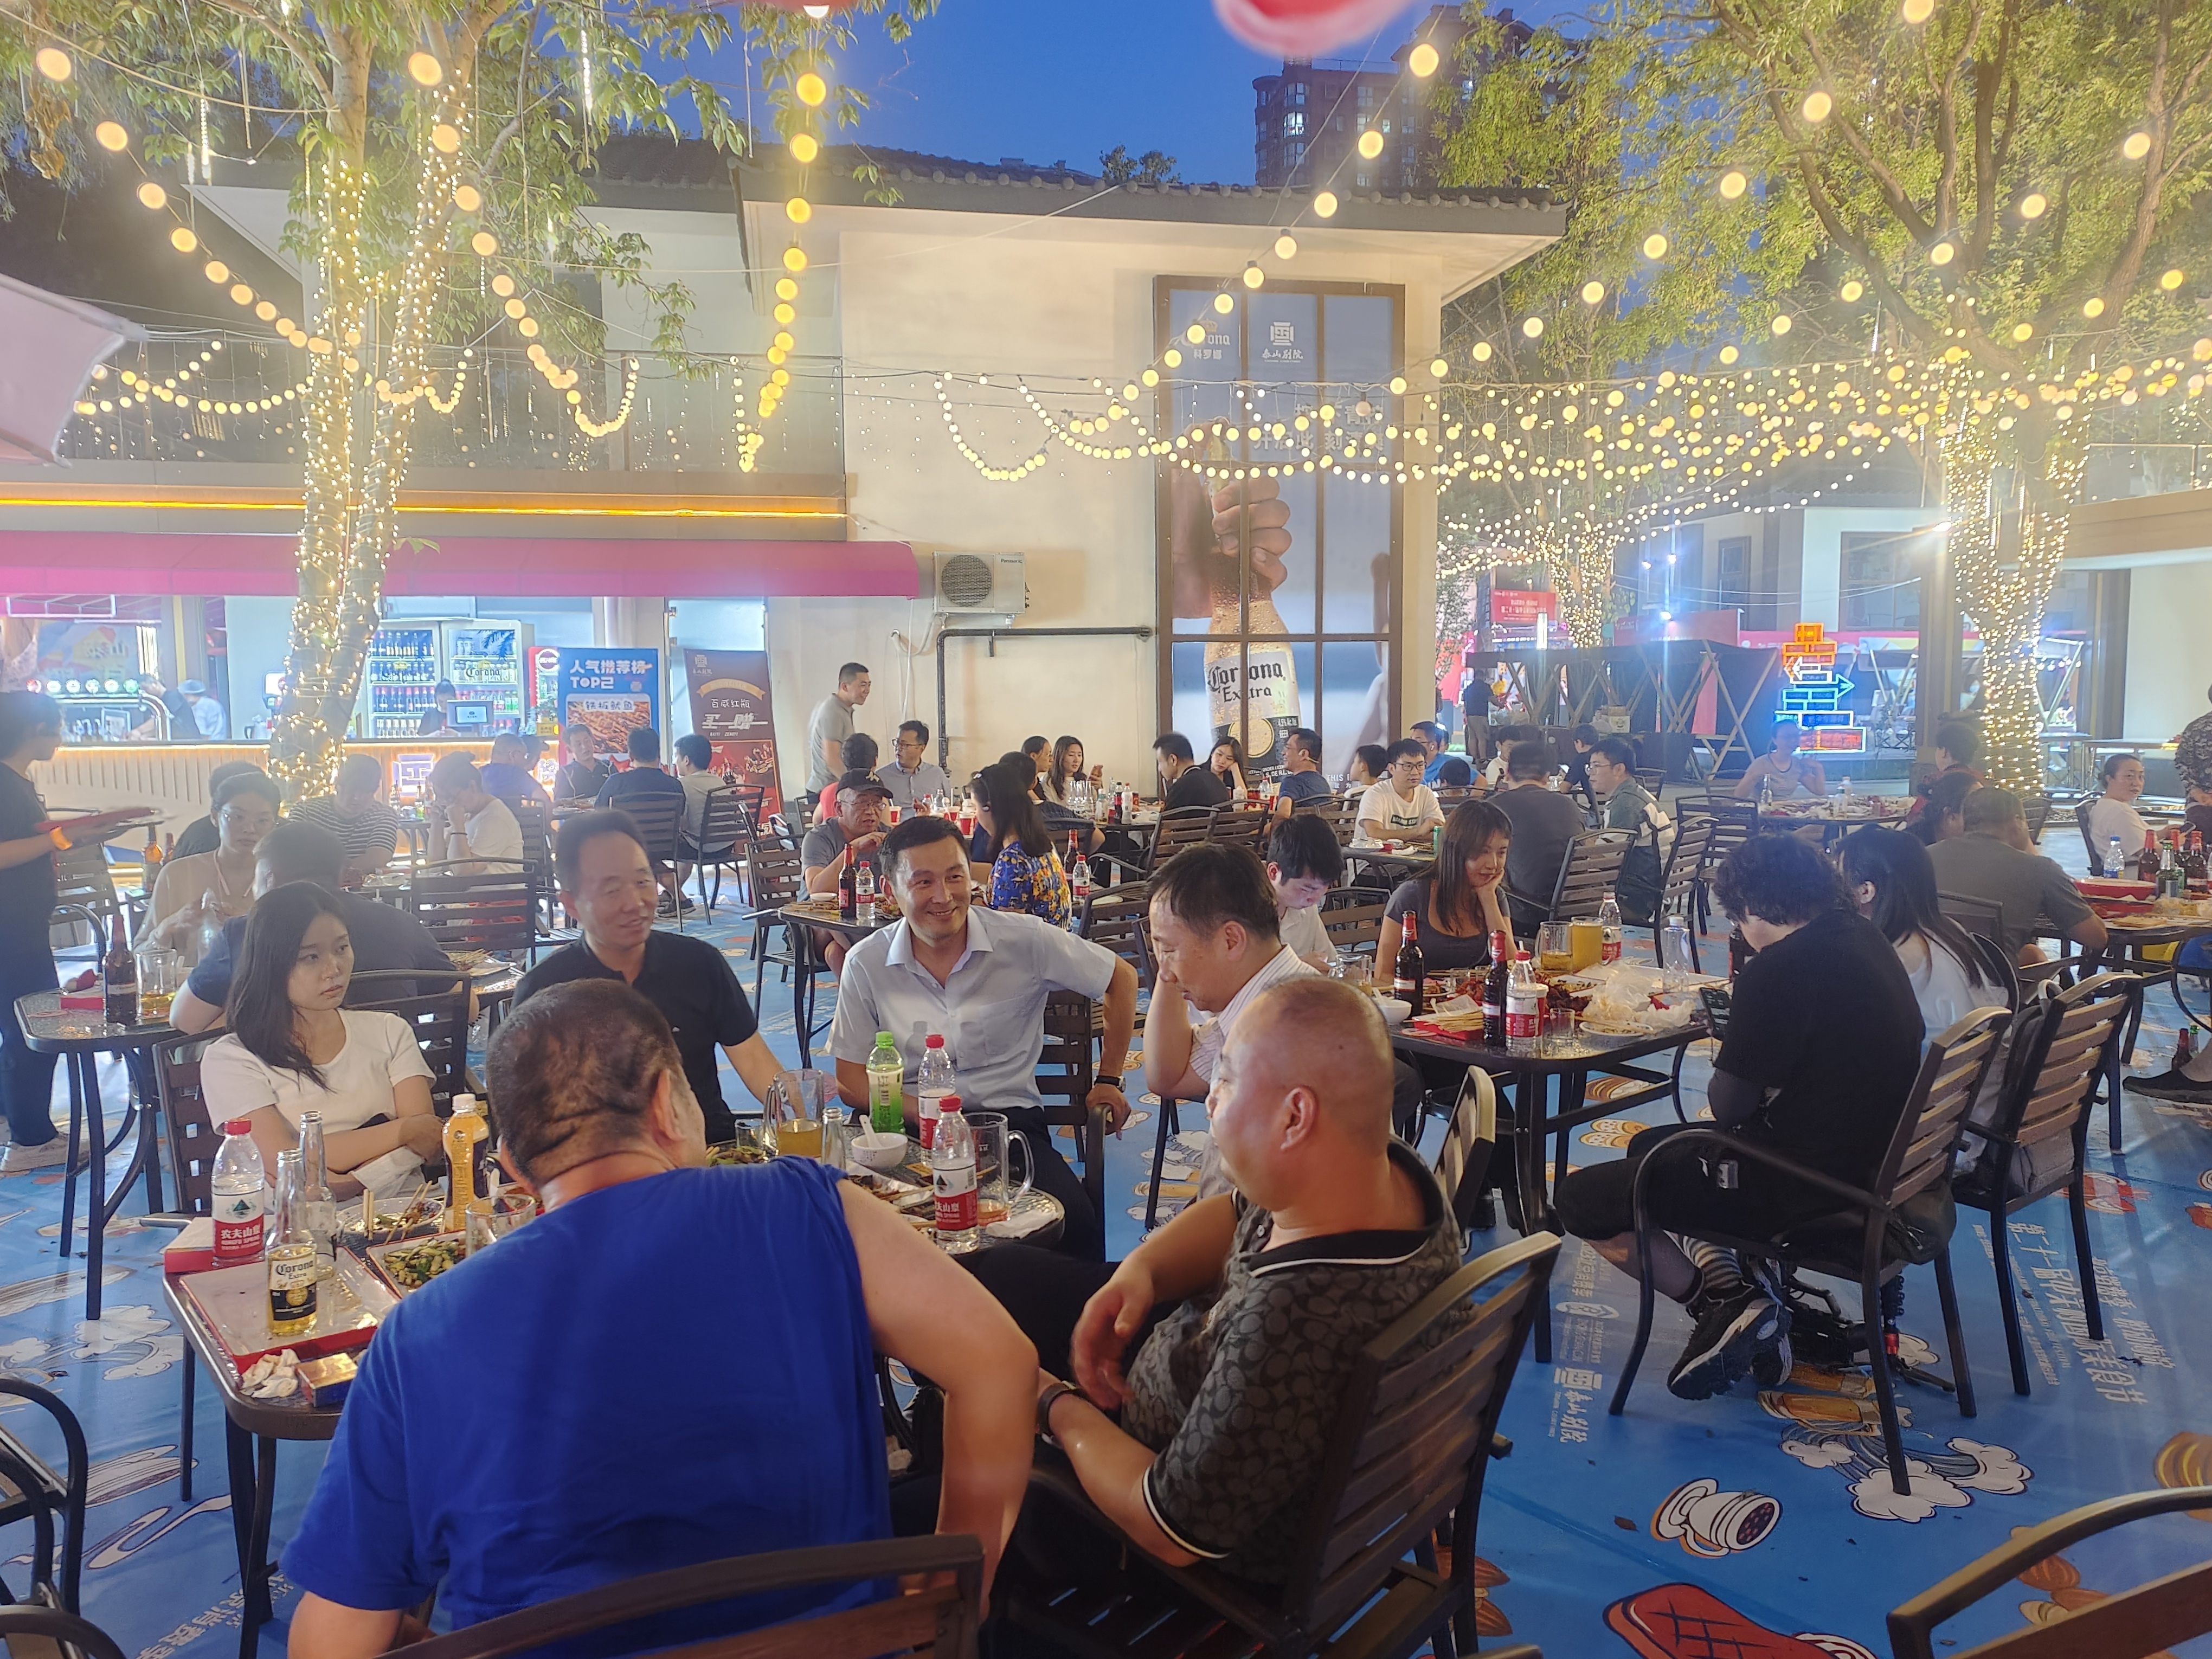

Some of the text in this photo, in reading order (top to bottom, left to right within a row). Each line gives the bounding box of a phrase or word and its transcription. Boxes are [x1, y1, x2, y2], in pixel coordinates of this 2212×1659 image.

[1262, 348, 1303, 359] 泰山别院
[570, 659, 646, 674] 人气推荐榜
[570, 677, 614, 689] TOP2
[711, 698, 750, 709] 百威红瓶
[935, 1201, 960, 1212] 夫山泉
[276, 1261, 313, 1275] Corona
